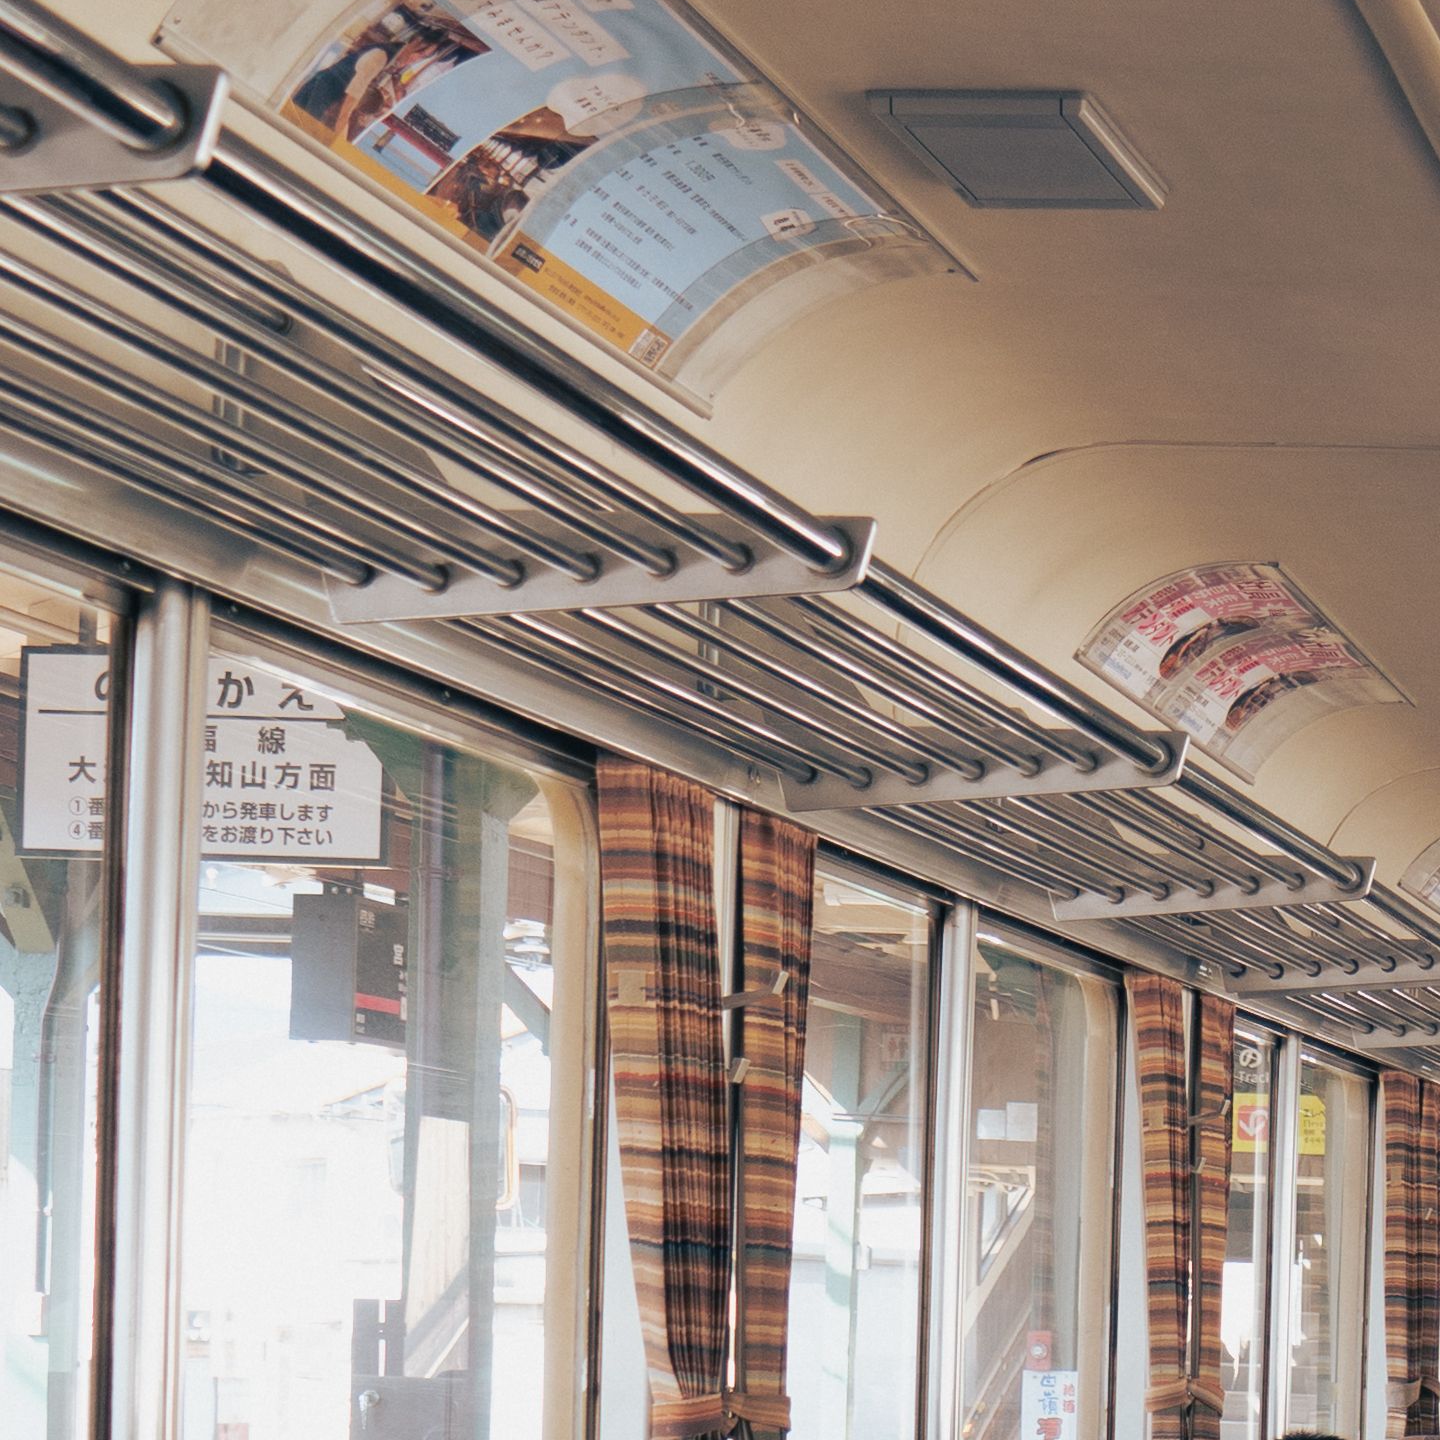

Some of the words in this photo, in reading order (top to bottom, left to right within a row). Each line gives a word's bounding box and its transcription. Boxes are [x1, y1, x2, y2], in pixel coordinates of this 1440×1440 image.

[206, 759, 336, 792] 知山方面
[202, 800, 333, 823] から発車します
[202, 825, 332, 846] をお渡り下さい
